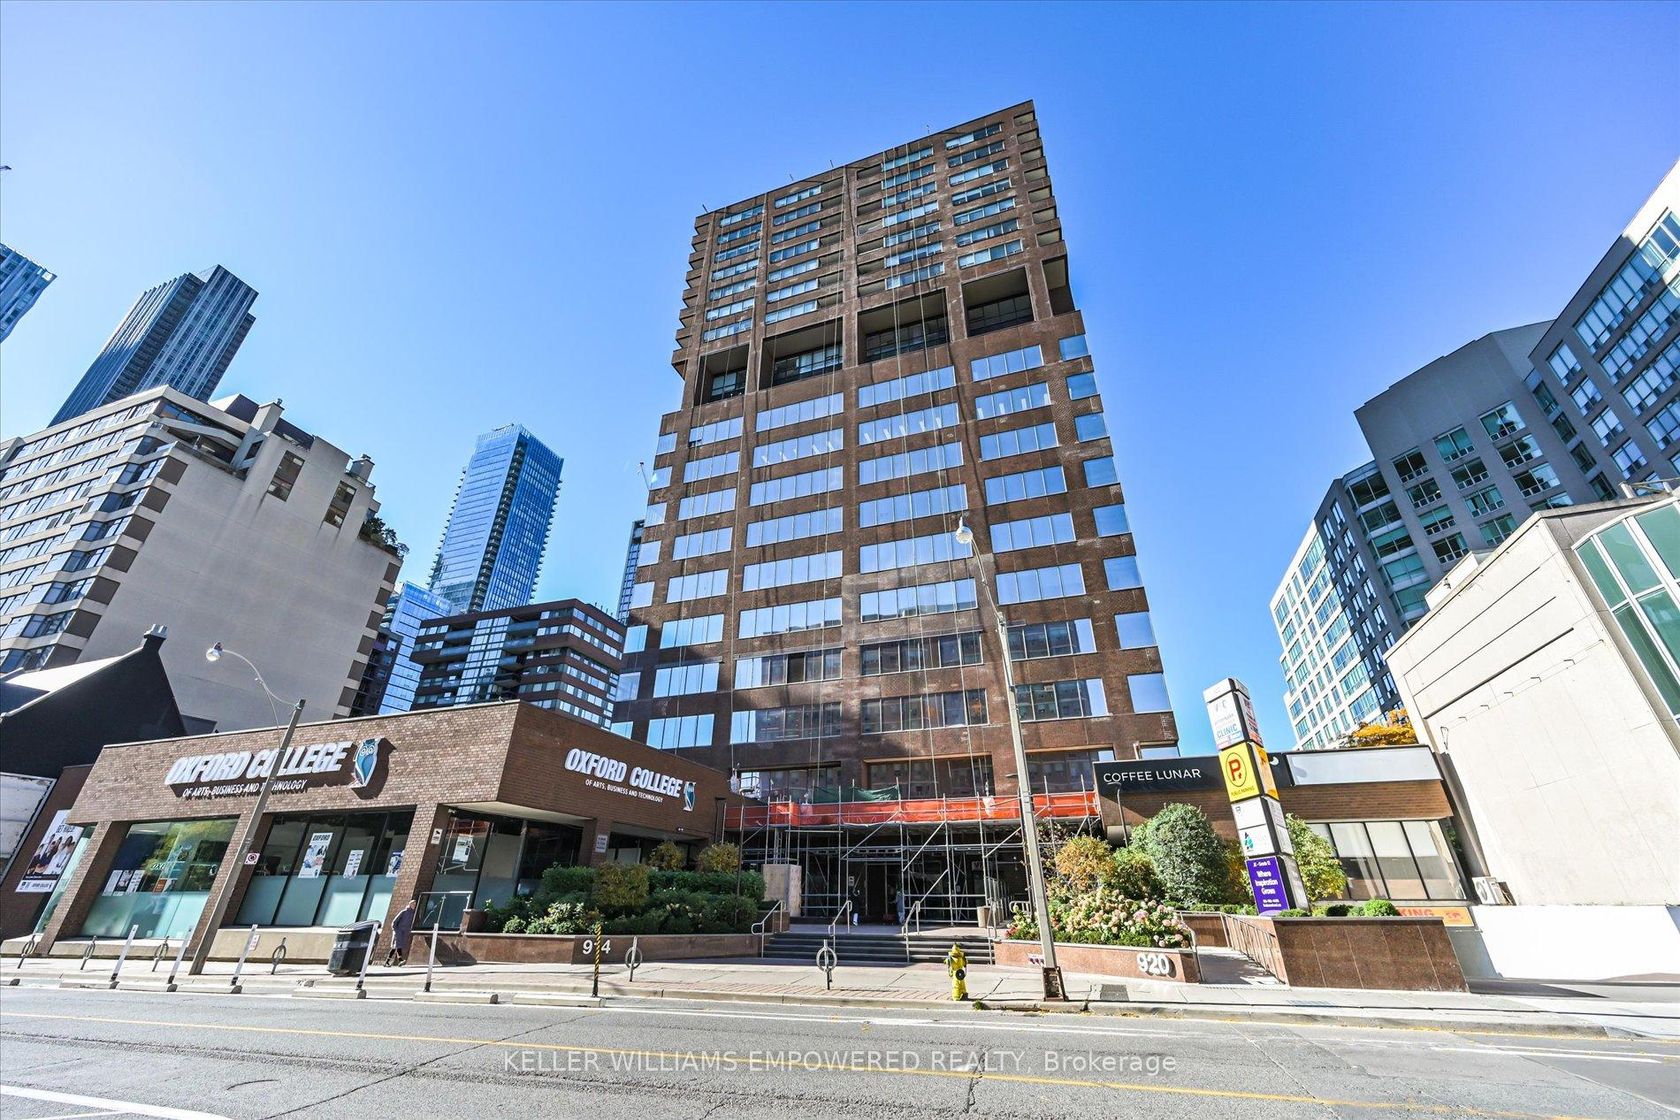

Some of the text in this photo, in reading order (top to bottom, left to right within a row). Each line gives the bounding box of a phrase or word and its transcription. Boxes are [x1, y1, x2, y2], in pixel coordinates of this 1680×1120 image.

[1217, 723, 1238, 738] CLINIC
[164, 741, 353, 785] OXFORD COLLEGE
[565, 748, 683, 798] OXFORD COLLEGE
[1104, 769, 1202, 782] COFFEE LUNAR
[182, 788, 192, 798] OF
[212, 784, 244, 795] BUSINESS
[243, 782, 260, 792] AND
[607, 784, 628, 795] BUSINESS
[638, 792, 663, 802] TECHNOLOGY
[582, 939, 611, 955] 94
[1137, 952, 1170, 975] 920
